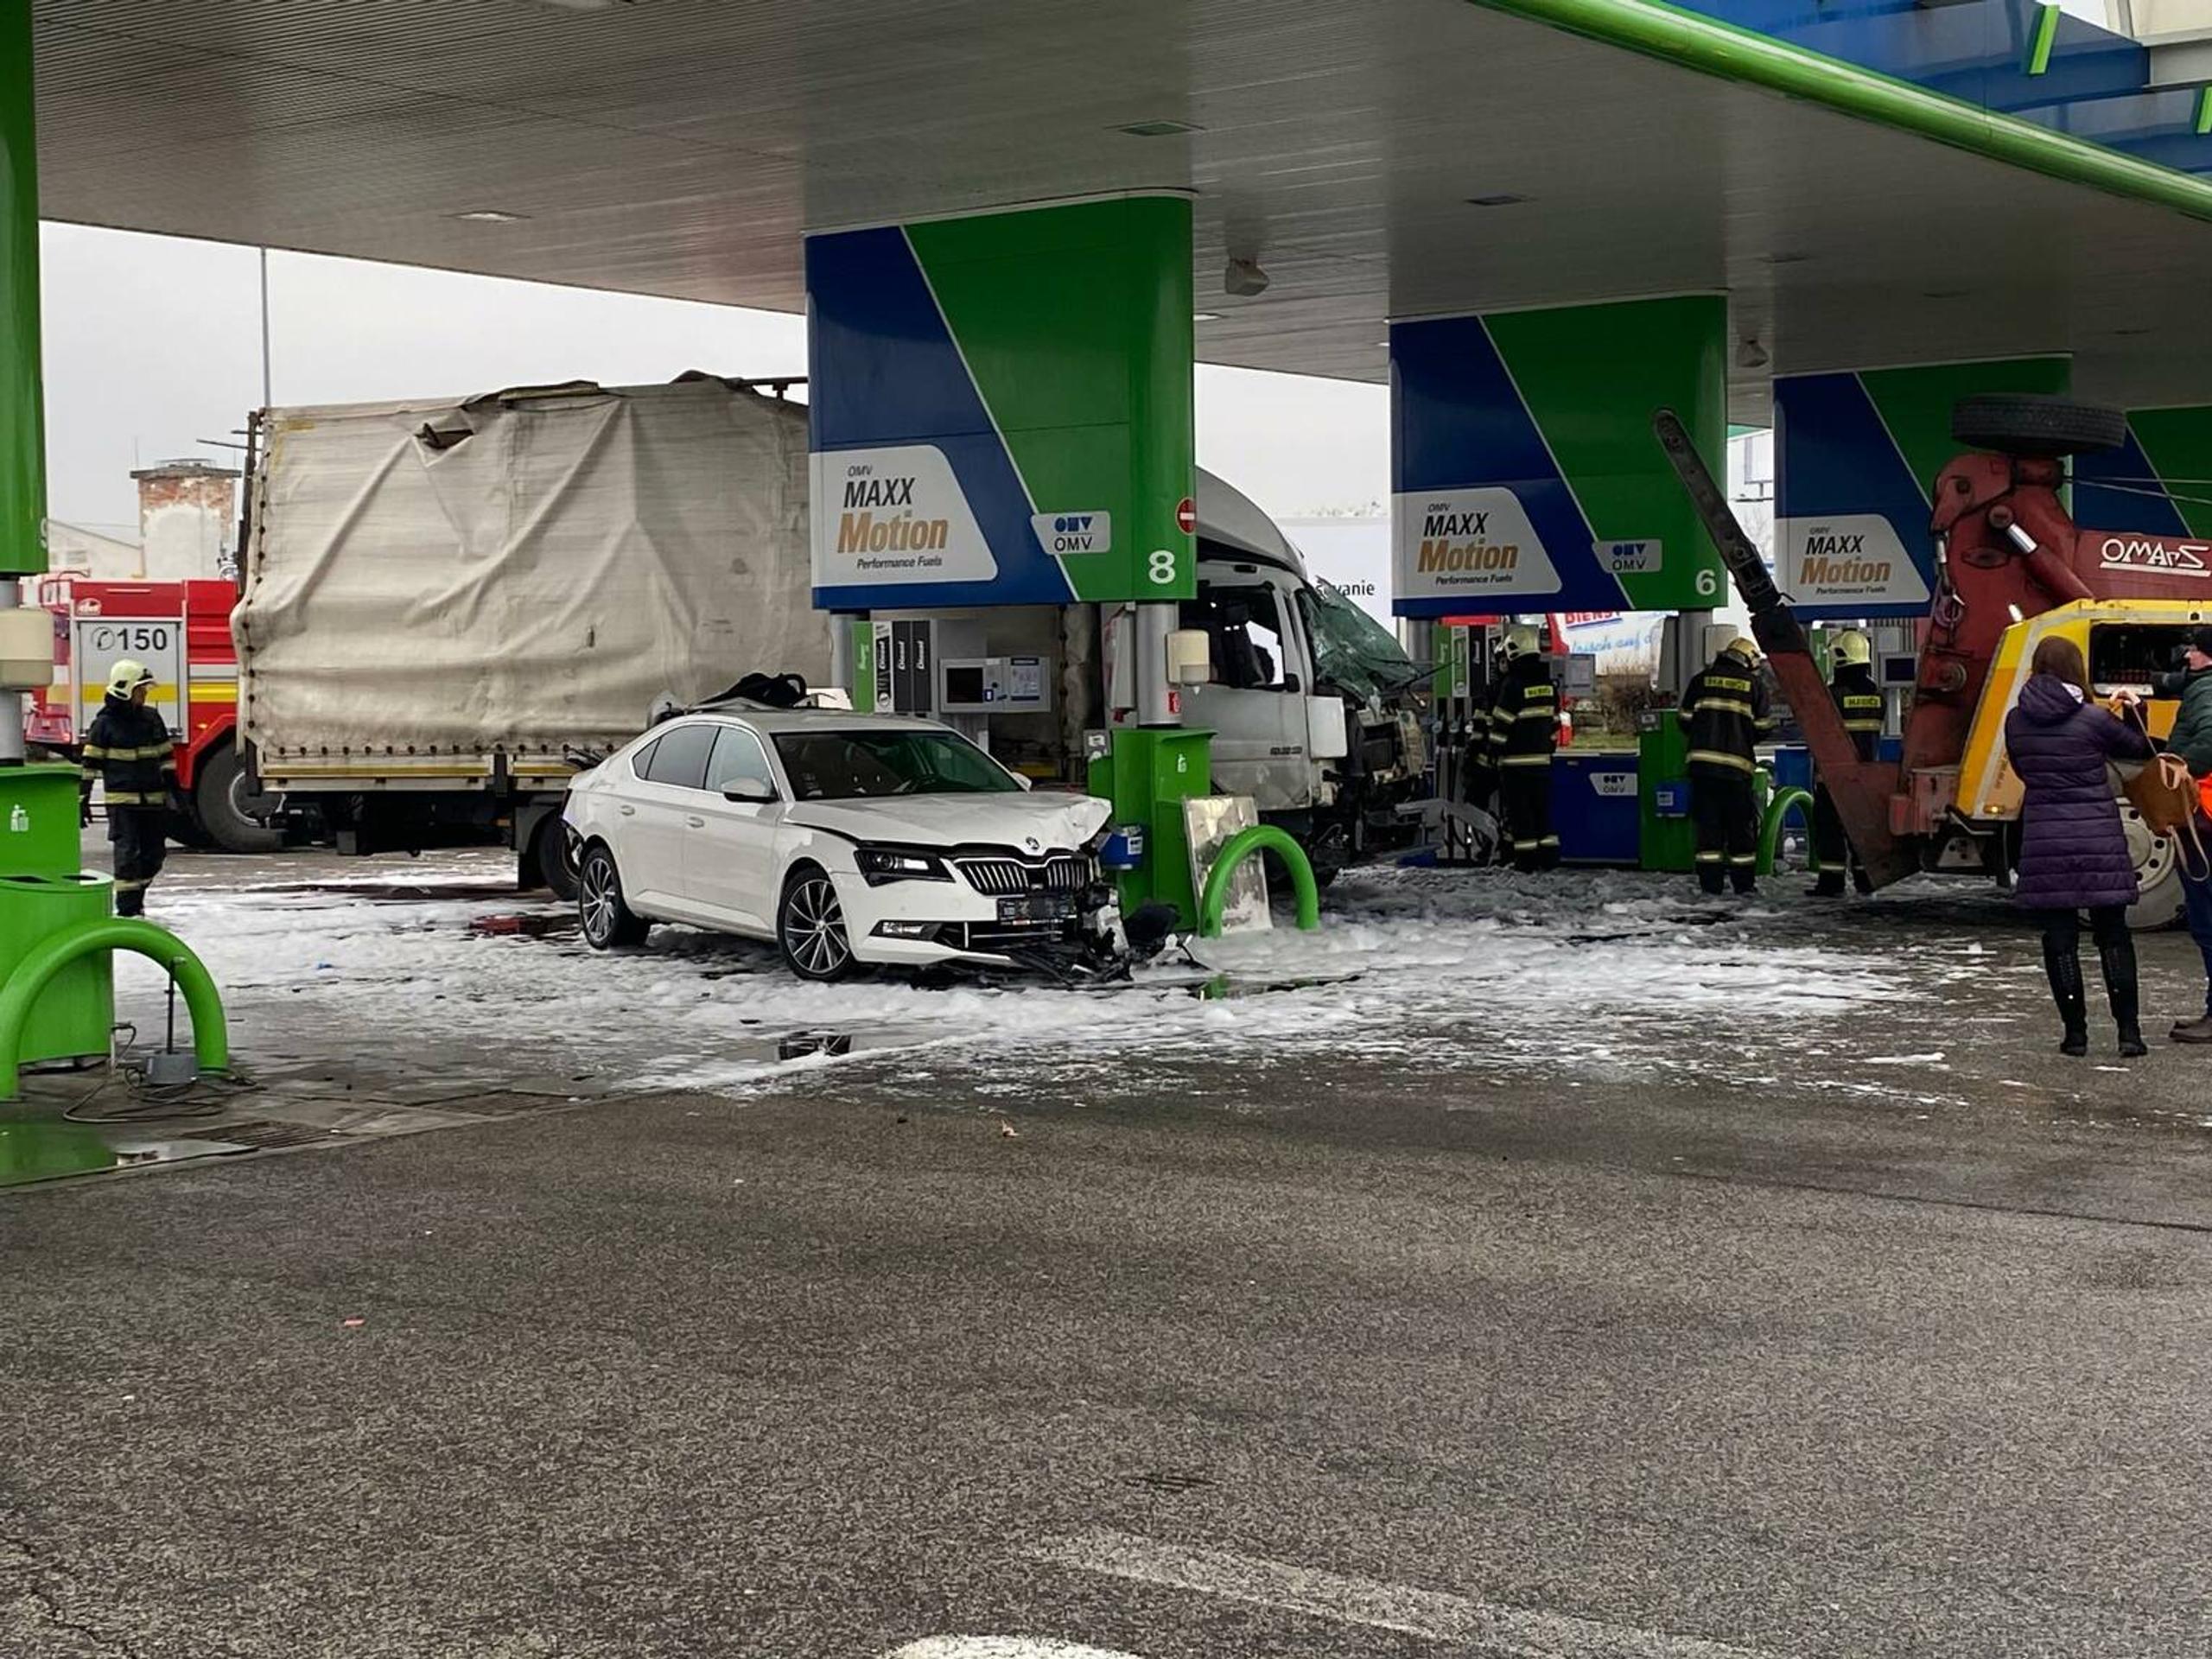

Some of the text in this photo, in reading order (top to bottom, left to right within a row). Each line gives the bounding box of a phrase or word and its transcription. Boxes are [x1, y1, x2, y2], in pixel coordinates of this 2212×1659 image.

[848, 465, 873, 477] OMV
[843, 477, 916, 508] MAXX
[1428, 503, 1452, 512] OMV
[836, 510, 948, 554] Motion
[1423, 512, 1489, 537] MAXX
[1054, 536, 1093, 552] OMV
[1416, 538, 1519, 573] Motion
[1806, 535, 1866, 555] MAXX
[856, 556, 943, 569] Performance Fuels
[1148, 550, 1176, 584] 8
[1612, 557, 1646, 571] OMV
[1799, 556, 1891, 585] Motion
[1435, 574, 1513, 586] Performance Fuels
[1695, 569, 1717, 595] 6
[117, 628, 167, 651] 150
